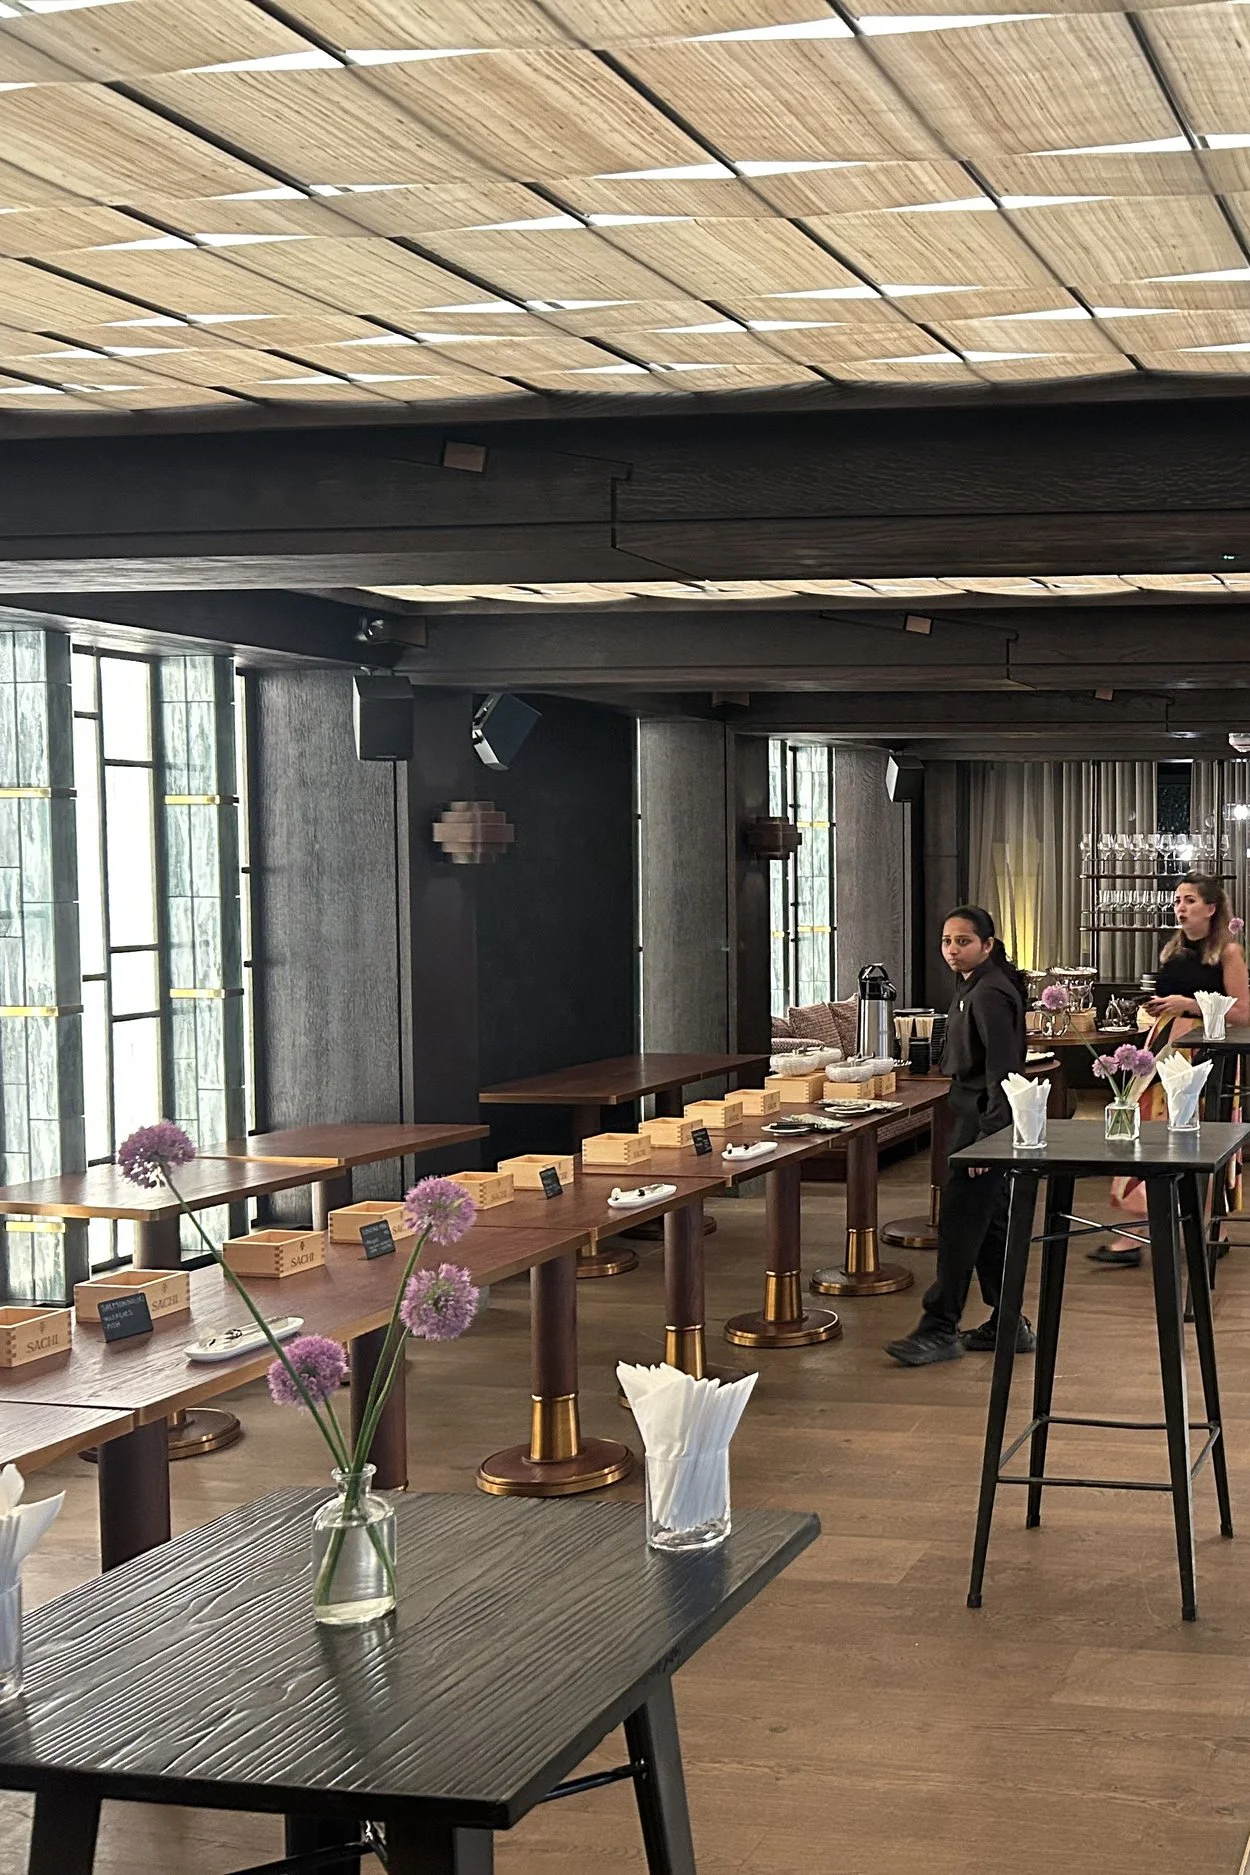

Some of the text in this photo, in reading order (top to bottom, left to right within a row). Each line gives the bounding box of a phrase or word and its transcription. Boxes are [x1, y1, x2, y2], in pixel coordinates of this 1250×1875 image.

[290, 1252, 315, 1268] SACHI
[151, 1294, 178, 1311] SACHI
[26, 1334, 59, 1354] SACHI
